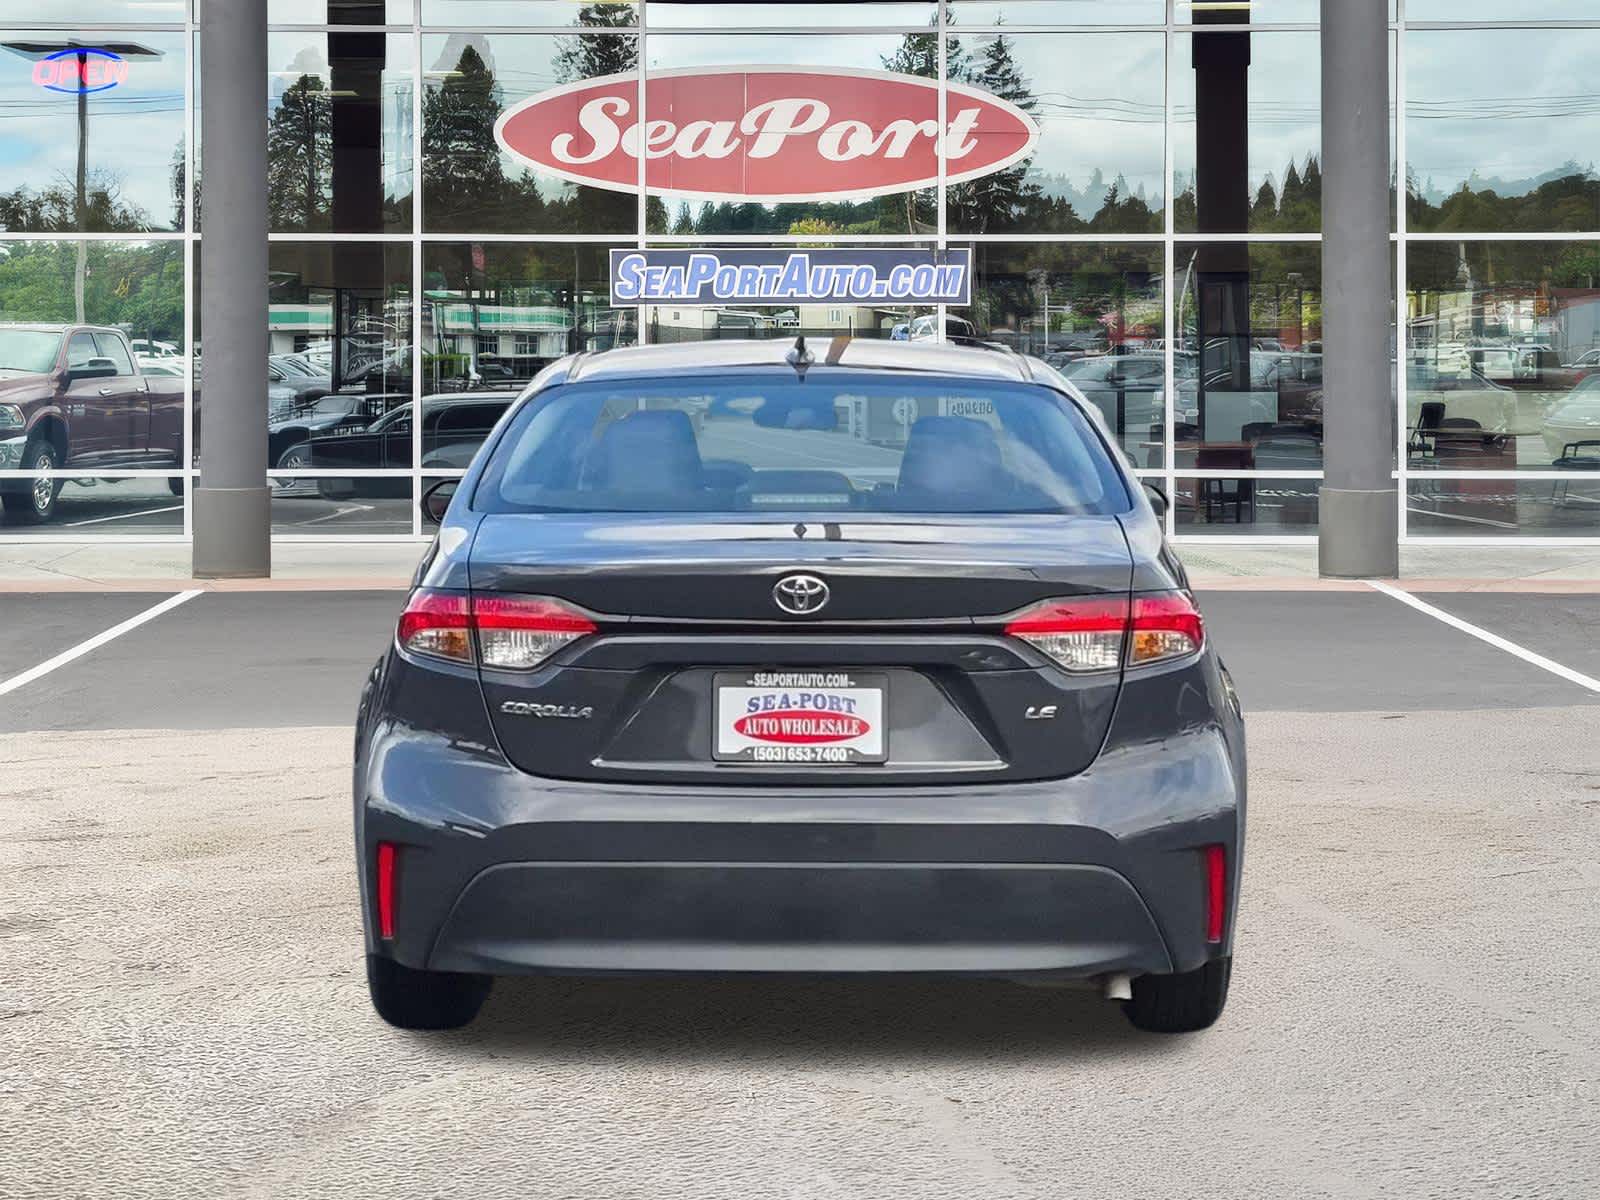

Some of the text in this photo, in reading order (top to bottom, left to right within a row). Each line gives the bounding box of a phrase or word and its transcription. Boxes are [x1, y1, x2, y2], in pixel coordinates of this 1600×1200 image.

[32, 59, 129, 86] OPEN
[550, 96, 982, 165] SeaPort
[753, 673, 849, 688] SEAPORTAUTO.COM
[500, 701, 593, 719] COROLLA
[746, 693, 857, 714] SEA-PORT
[1024, 705, 1058, 719] LE
[743, 717, 861, 736] AUTO WHOLESALE
